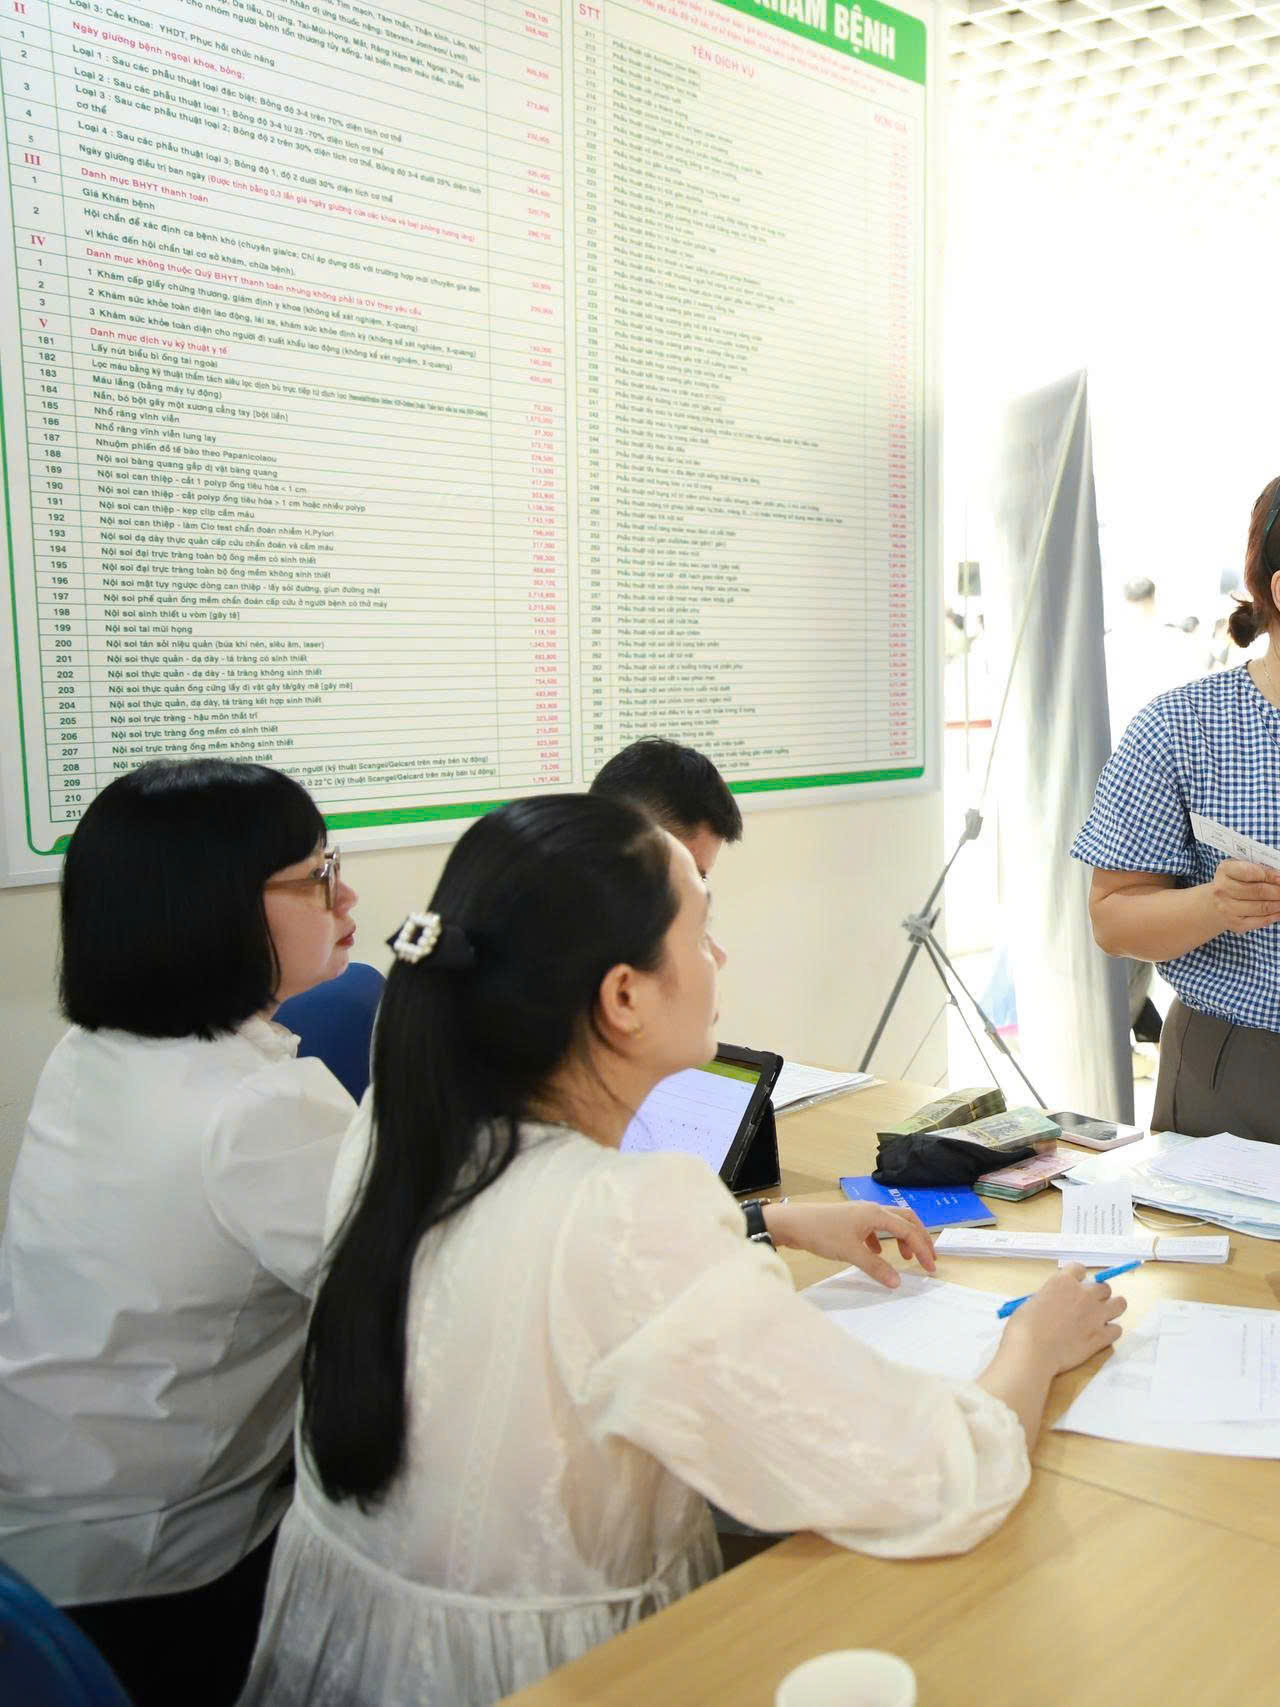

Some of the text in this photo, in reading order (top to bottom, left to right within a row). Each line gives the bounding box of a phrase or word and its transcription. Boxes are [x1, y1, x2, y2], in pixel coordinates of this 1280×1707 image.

[579, 3, 600, 20] STT
[833, 3, 896, 60] BỆNH
[24, 153, 40, 165] III
[37, 336, 53, 344] 181
[38, 352, 55, 361] 182
[40, 368, 56, 377] 183
[40, 384, 57, 393] 184
[41, 401, 58, 409] 185
[42, 417, 59, 425] 186
[43, 433, 60, 441] 187
[44, 449, 61, 457] 188
[45, 465, 62, 473] 189
[46, 481, 63, 489] 190
[47, 497, 62, 505] 191
[48, 513, 64, 521] 192
[49, 529, 65, 537] 193
[51, 576, 68, 584] 196
[52, 592, 68, 600] 197
[54, 623, 70, 631] 199
[55, 639, 71, 647] 200
[57, 670, 73, 678] 202
[58, 701, 75, 709] 204
[59, 717, 76, 725] 205
[60, 732, 77, 740] 206
[62, 748, 78, 756] 207
[62, 763, 79, 771] 208
[64, 778, 80, 786] 209
[65, 794, 81, 802] 210
[66, 810, 82, 818] 211
